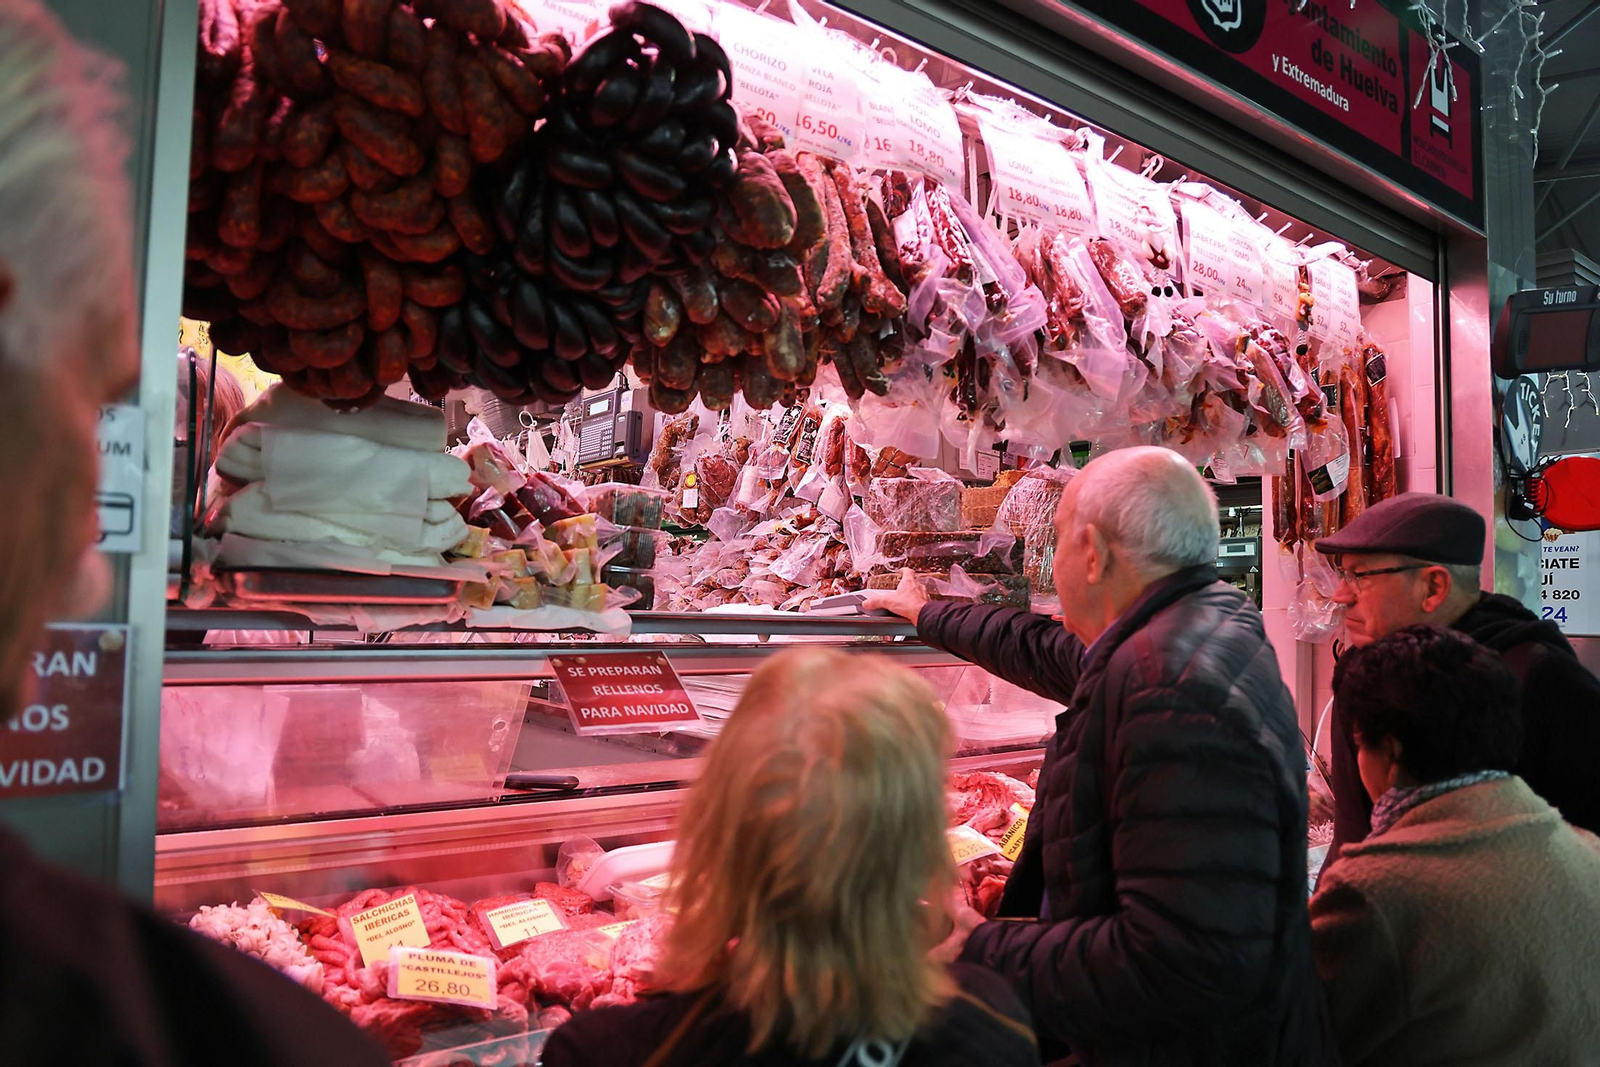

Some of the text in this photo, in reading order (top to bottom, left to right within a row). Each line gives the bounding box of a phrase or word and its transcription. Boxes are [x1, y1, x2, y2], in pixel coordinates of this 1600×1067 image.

[733, 42, 787, 72] CHORIZO
[811, 66, 835, 80] VELA
[1312, 38, 1398, 114] de Huelva
[763, 72, 796, 91] BLANCO
[808, 79, 833, 95] ROJA
[1272, 53, 1349, 112] y Extremadura
[910, 114, 941, 139] LOMO
[908, 139, 944, 168] 18,80
[1008, 159, 1033, 175] LOMO
[1008, 186, 1040, 207] 18,80
[1054, 204, 1082, 221] 18,80
[1191, 230, 1228, 253] CABECERO
[1192, 260, 1219, 280] 28,00
[1236, 276, 1246, 289] 24
[1555, 290, 1577, 304] turno
[1316, 314, 1325, 327] 52
[1340, 321, 1347, 333] 52
[1520, 383, 1541, 453] TICKET
[1554, 545, 1580, 553] VEAN?
[1552, 589, 1580, 600] 820
[1541, 606, 1568, 623] 24
[567, 665, 663, 678] SE PREPARAN
[592, 684, 664, 697] RELLENOS
[580, 703, 689, 719] PARA NAVIDAD
[998, 818, 1026, 849] ABANICOS
[352, 896, 414, 925] SALCHICHAS
[364, 908, 411, 932] IBÉRICAS
[366, 933, 383, 942] "DEL
[408, 953, 477, 968] PLUMA DE
[401, 964, 487, 979] "CASTILLEJOS"
